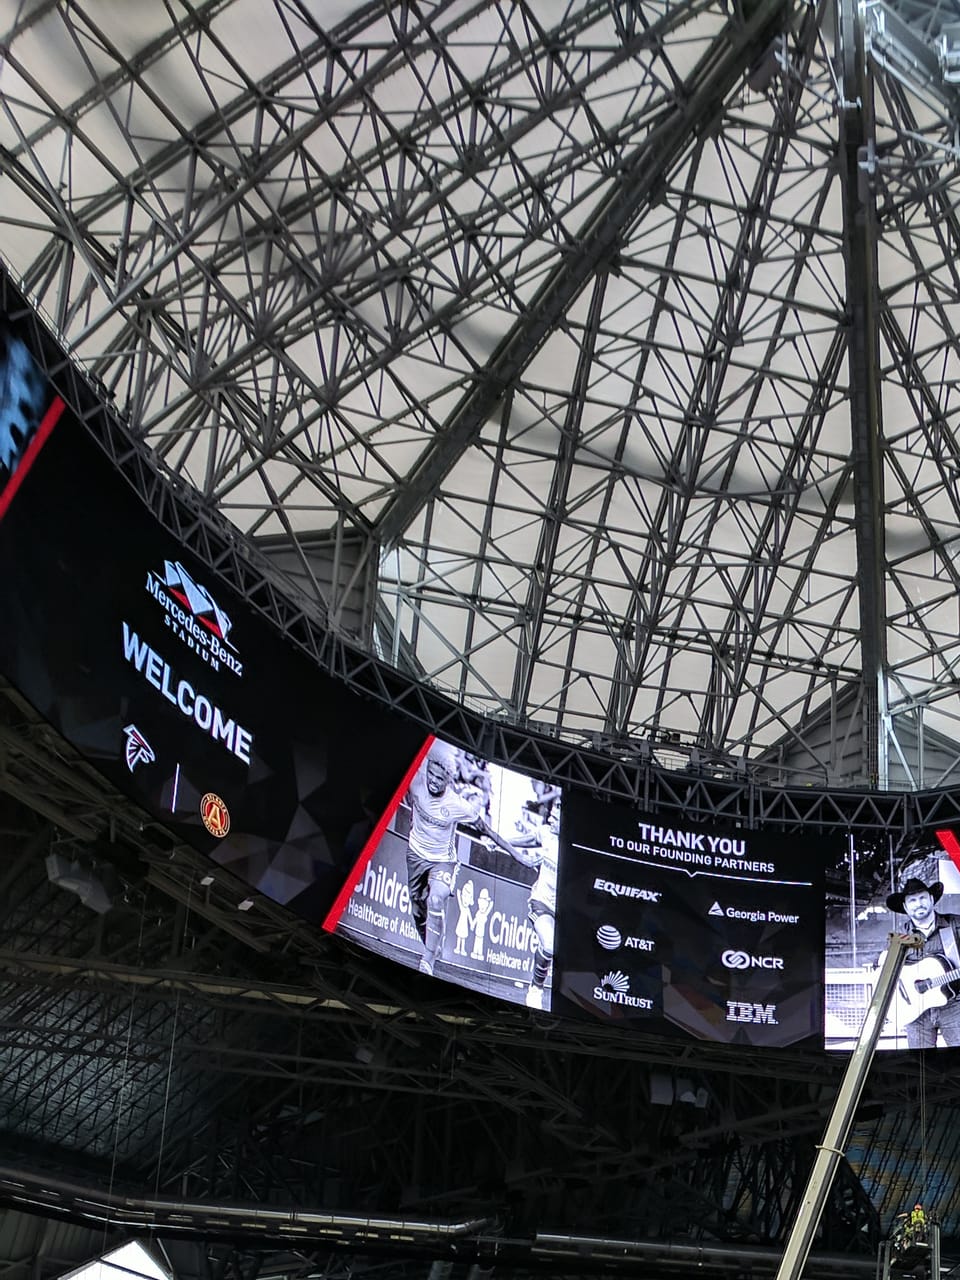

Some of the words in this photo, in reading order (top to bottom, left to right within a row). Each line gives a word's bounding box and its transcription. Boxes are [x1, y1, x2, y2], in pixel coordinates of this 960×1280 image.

[145, 571, 243, 677] Mercedes-Benz
[164, 614, 220, 673] STADIUM
[122, 621, 253, 766] WELCOME
[638, 822, 704, 850] THANK
[707, 836, 745, 856] YOU
[609, 836, 624, 849] TO
[627, 841, 650, 855] OUR
[653, 846, 712, 866] FOUNDING
[714, 856, 775, 873] PARTNERS
[435, 870, 451, 884] 26
[593, 878, 660, 902] EQUIFAX
[348, 898, 389, 930] Healthcare
[389, 917, 399, 933] of
[726, 907, 766, 922] Georgia
[768, 911, 800, 924] Power
[489, 911, 539, 953] Childre
[624, 936, 655, 951] AT&T
[486, 948, 521, 970] Healthcare
[521, 956, 530, 970] of
[751, 956, 784, 970] NCR
[726, 1000, 778, 1025] IBM
